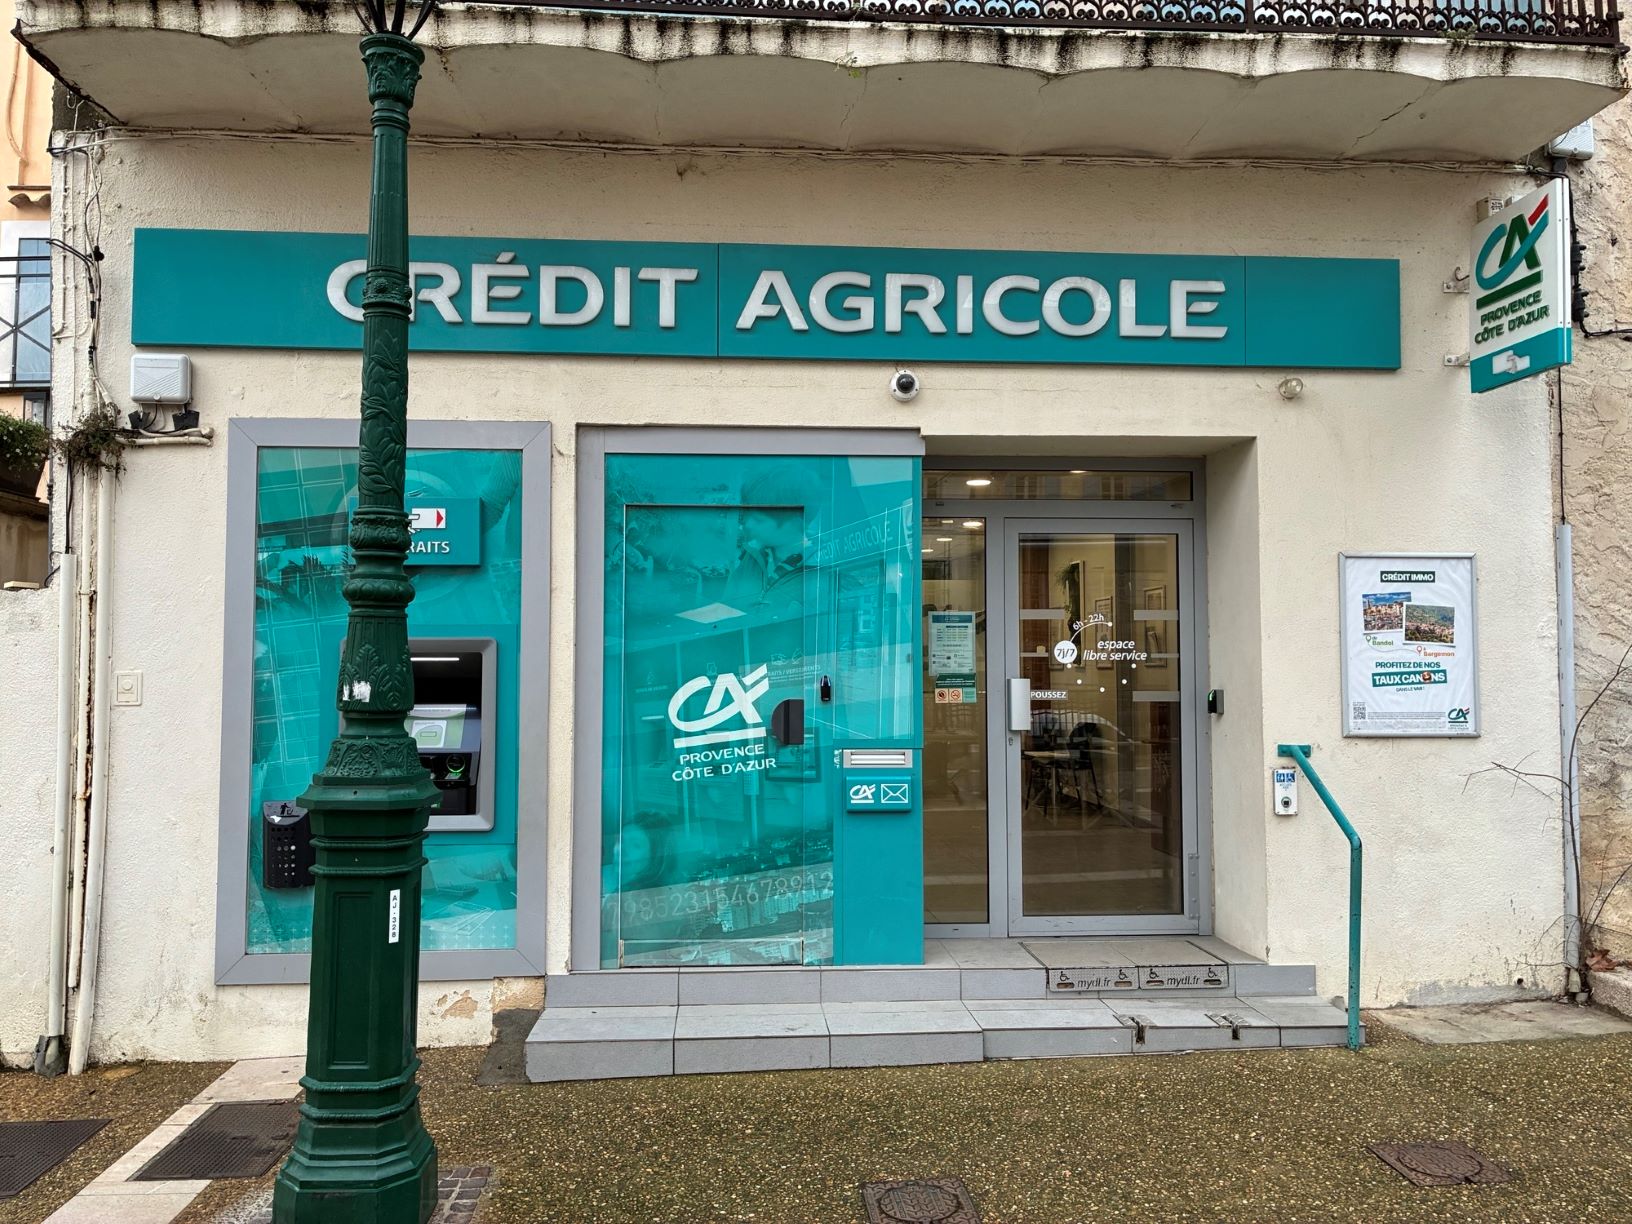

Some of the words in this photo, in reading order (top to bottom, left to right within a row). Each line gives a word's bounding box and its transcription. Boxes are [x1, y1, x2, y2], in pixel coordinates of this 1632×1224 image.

[326, 252, 699, 328] CRÉDIT
[735, 270, 1228, 338] AGRICOLE
[1480, 290, 1543, 326] PROVENCE
[1474, 323, 1505, 345] CÔTE
[1508, 304, 1550, 332] D'AZUR
[406, 540, 450, 554] RAITS
[1381, 572, 1410, 582] CRÉDIT
[1411, 573, 1434, 582] IMMO
[1072, 620, 1084, 631] 6h
[1088, 613, 1105, 623] 22h
[1097, 640, 1136, 651] espace
[1055, 647, 1076, 660] 7j/7
[1082, 649, 1107, 661] libre
[1109, 650, 1148, 661] service
[1375, 661, 1412, 669] PROFITEZ
[1373, 675, 1401, 685] TAUX
[1030, 691, 1067, 699] POUSSEZ
[679, 743, 765, 765] PROVENCE
[672, 765, 714, 782] CÔTE
[721, 757, 777, 775] D'AZUR
[1077, 977, 1111, 988] mydl.fr
[1166, 976, 1200, 987] mydl.fr
